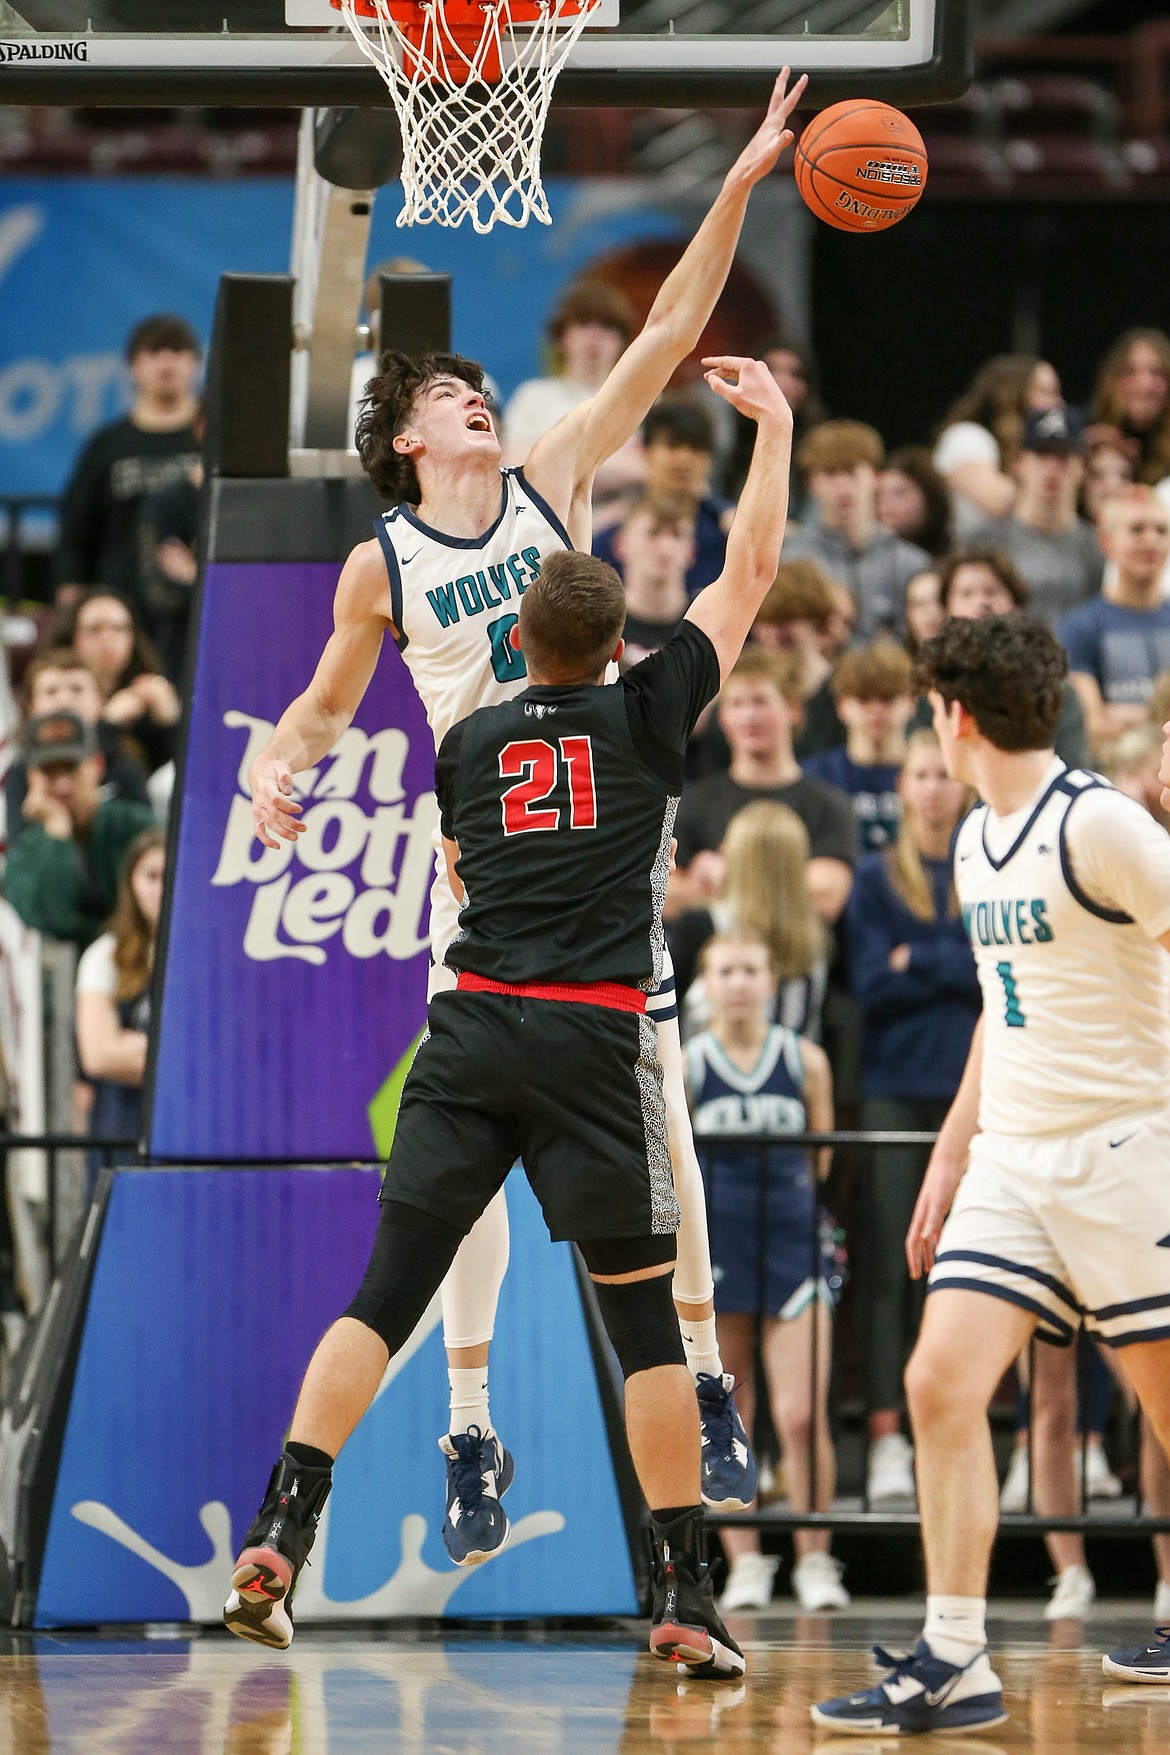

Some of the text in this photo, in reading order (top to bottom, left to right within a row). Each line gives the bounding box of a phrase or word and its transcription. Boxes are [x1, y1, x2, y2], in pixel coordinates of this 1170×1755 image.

[856, 168, 922, 187] PRECISION
[425, 546, 541, 629] WOLVES
[498, 735, 597, 836] 21
[996, 962, 1025, 1027] 1
